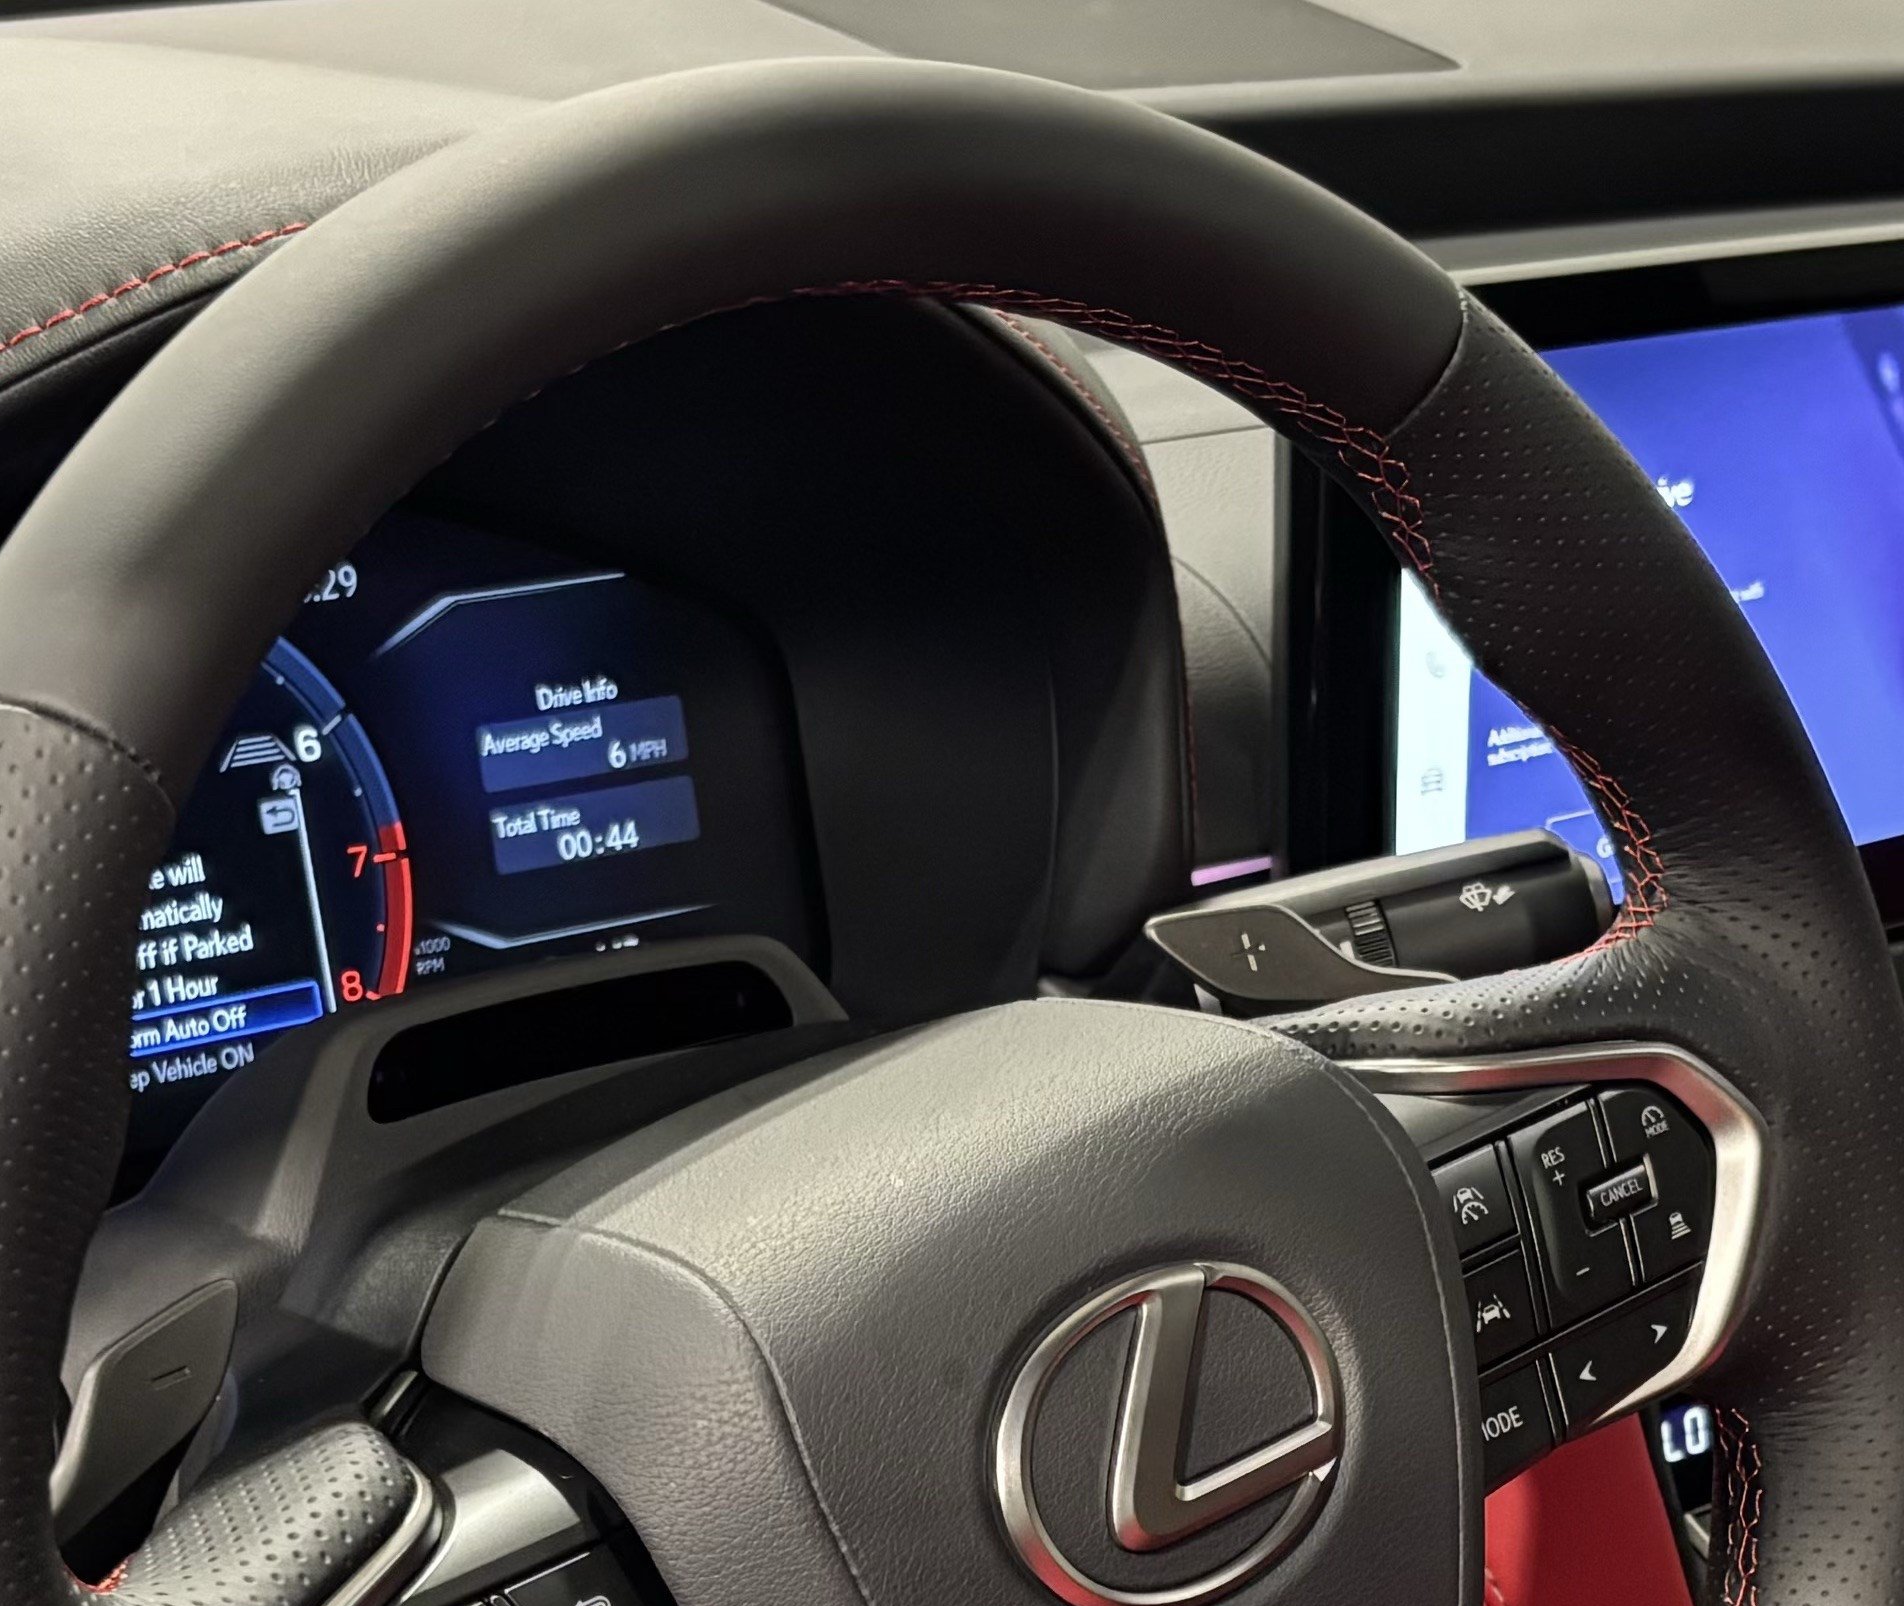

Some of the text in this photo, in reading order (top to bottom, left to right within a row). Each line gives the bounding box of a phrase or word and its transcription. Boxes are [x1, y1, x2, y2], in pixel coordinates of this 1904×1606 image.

[534, 676, 618, 711] Drive Info
[295, 728, 322, 764] 6
[481, 715, 603, 757] Average Speed
[608, 738, 668, 769] 6 MPH
[491, 806, 581, 839] Total Time
[557, 819, 639, 861] 00:44
[167, 852, 206, 888] will
[347, 845, 369, 878] 7
[161, 937, 179, 966] if
[180, 922, 254, 962] Parked
[164, 974, 218, 1004] Hour
[340, 970, 364, 1002] 8
[164, 1016, 210, 1044] Auto
[212, 1004, 248, 1030] Off
[151, 1053, 218, 1085] Vehicle
[220, 1041, 255, 1070] ON
[1539, 1145, 1567, 1171] RES
[1599, 1176, 1645, 1208] CANCEL
